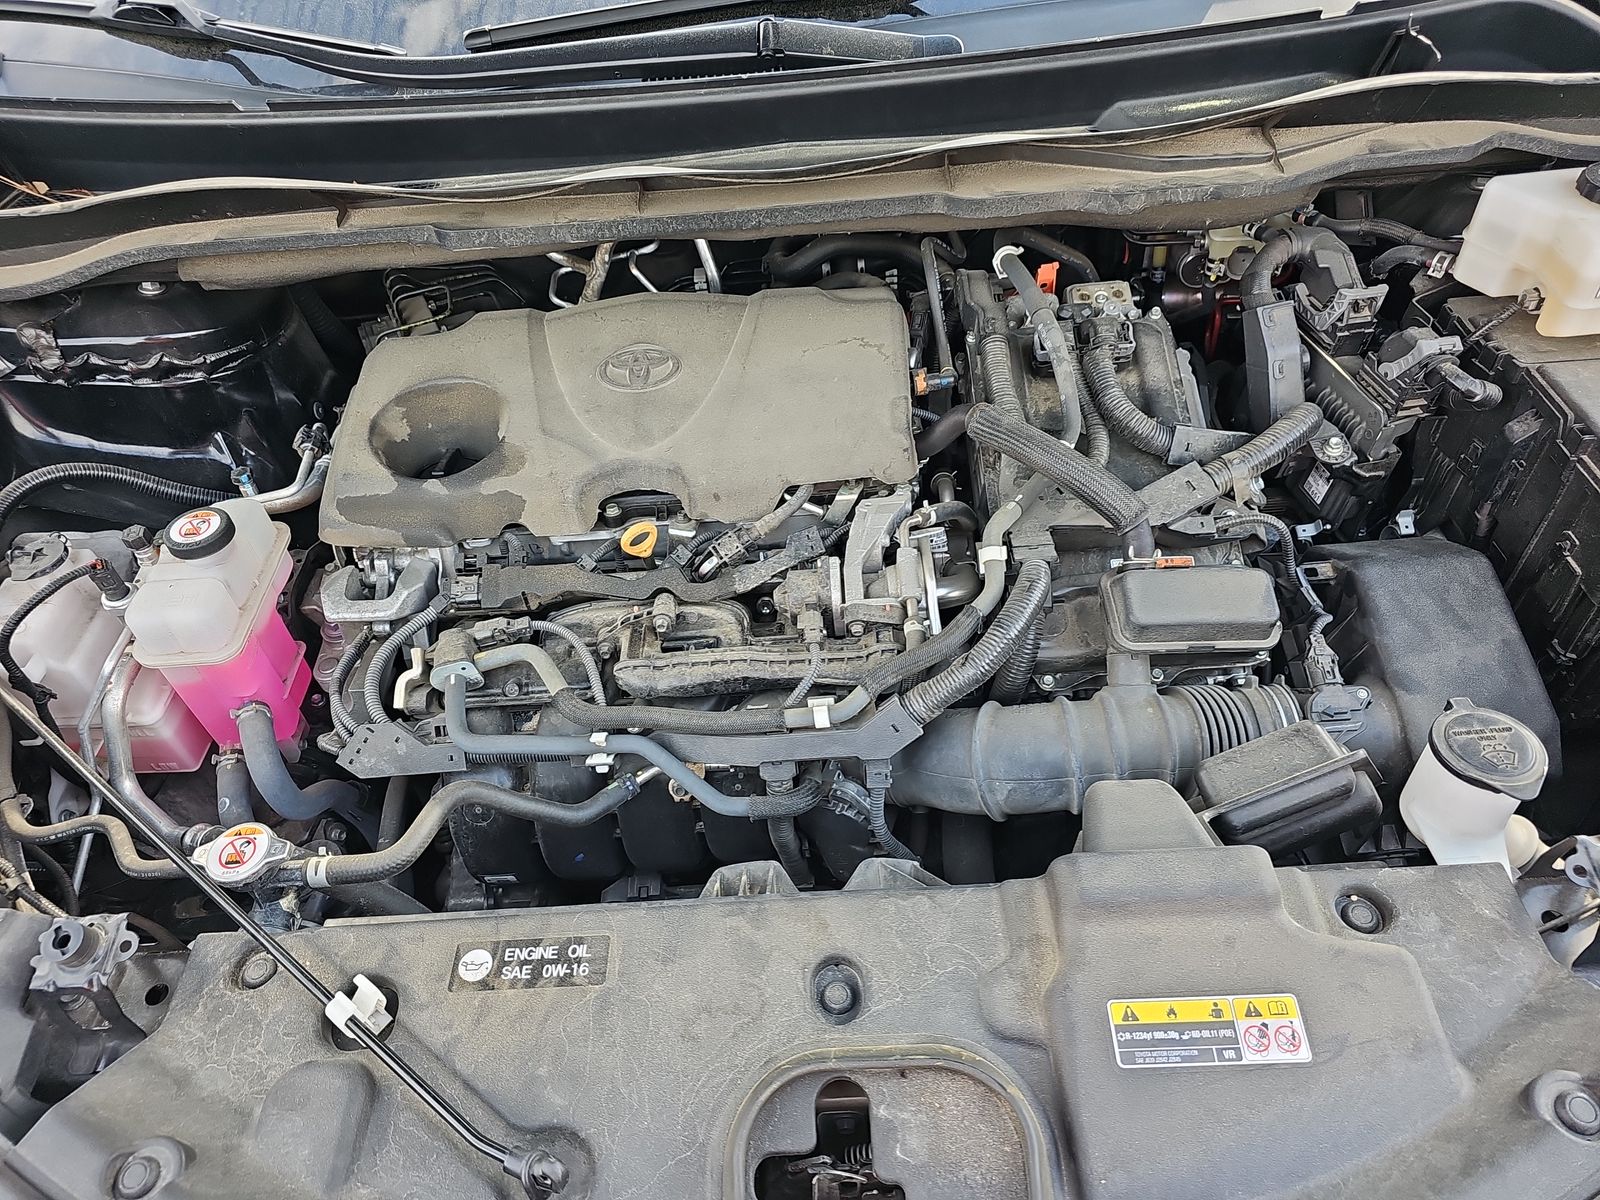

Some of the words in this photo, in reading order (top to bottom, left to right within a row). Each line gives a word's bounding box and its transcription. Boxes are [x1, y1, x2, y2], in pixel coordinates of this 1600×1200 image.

[504, 946, 559, 961] ENGINE
[568, 944, 592, 961] OIL
[501, 965, 533, 979] SAE
[542, 963, 589, 978] 0W-16
[1222, 1050, 1236, 1059] VR
